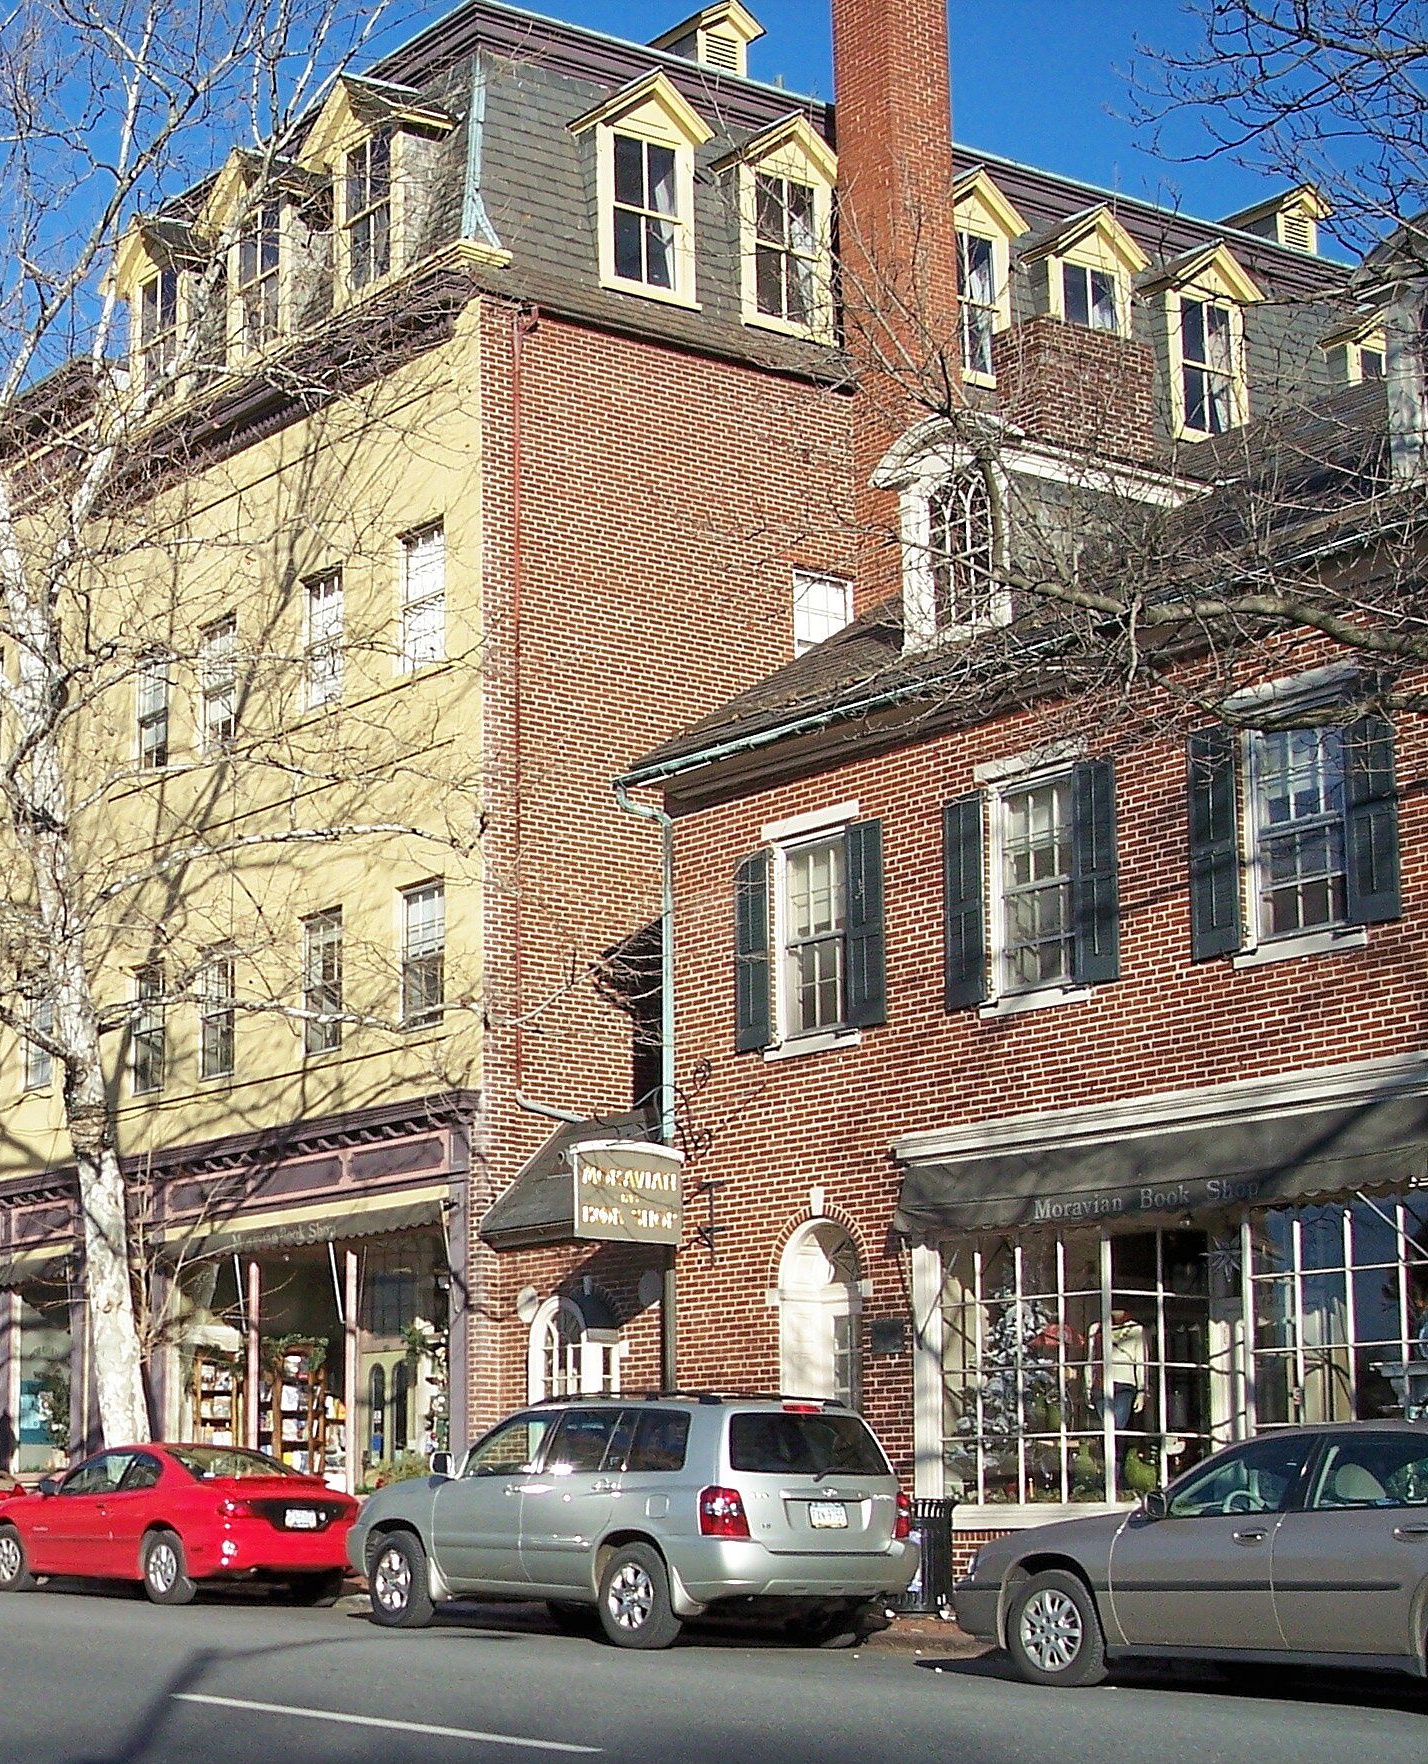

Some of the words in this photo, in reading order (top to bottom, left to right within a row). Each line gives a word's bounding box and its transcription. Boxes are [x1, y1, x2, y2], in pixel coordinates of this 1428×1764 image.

[582, 1167, 676, 1191] MORAVIAN
[1034, 1195, 1122, 1220] Moravian
[1140, 1186, 1190, 1210] Book
[1206, 1179, 1260, 1200] Shop
[582, 1205, 625, 1226] BOOK
[630, 1208, 678, 1230] SHOP
